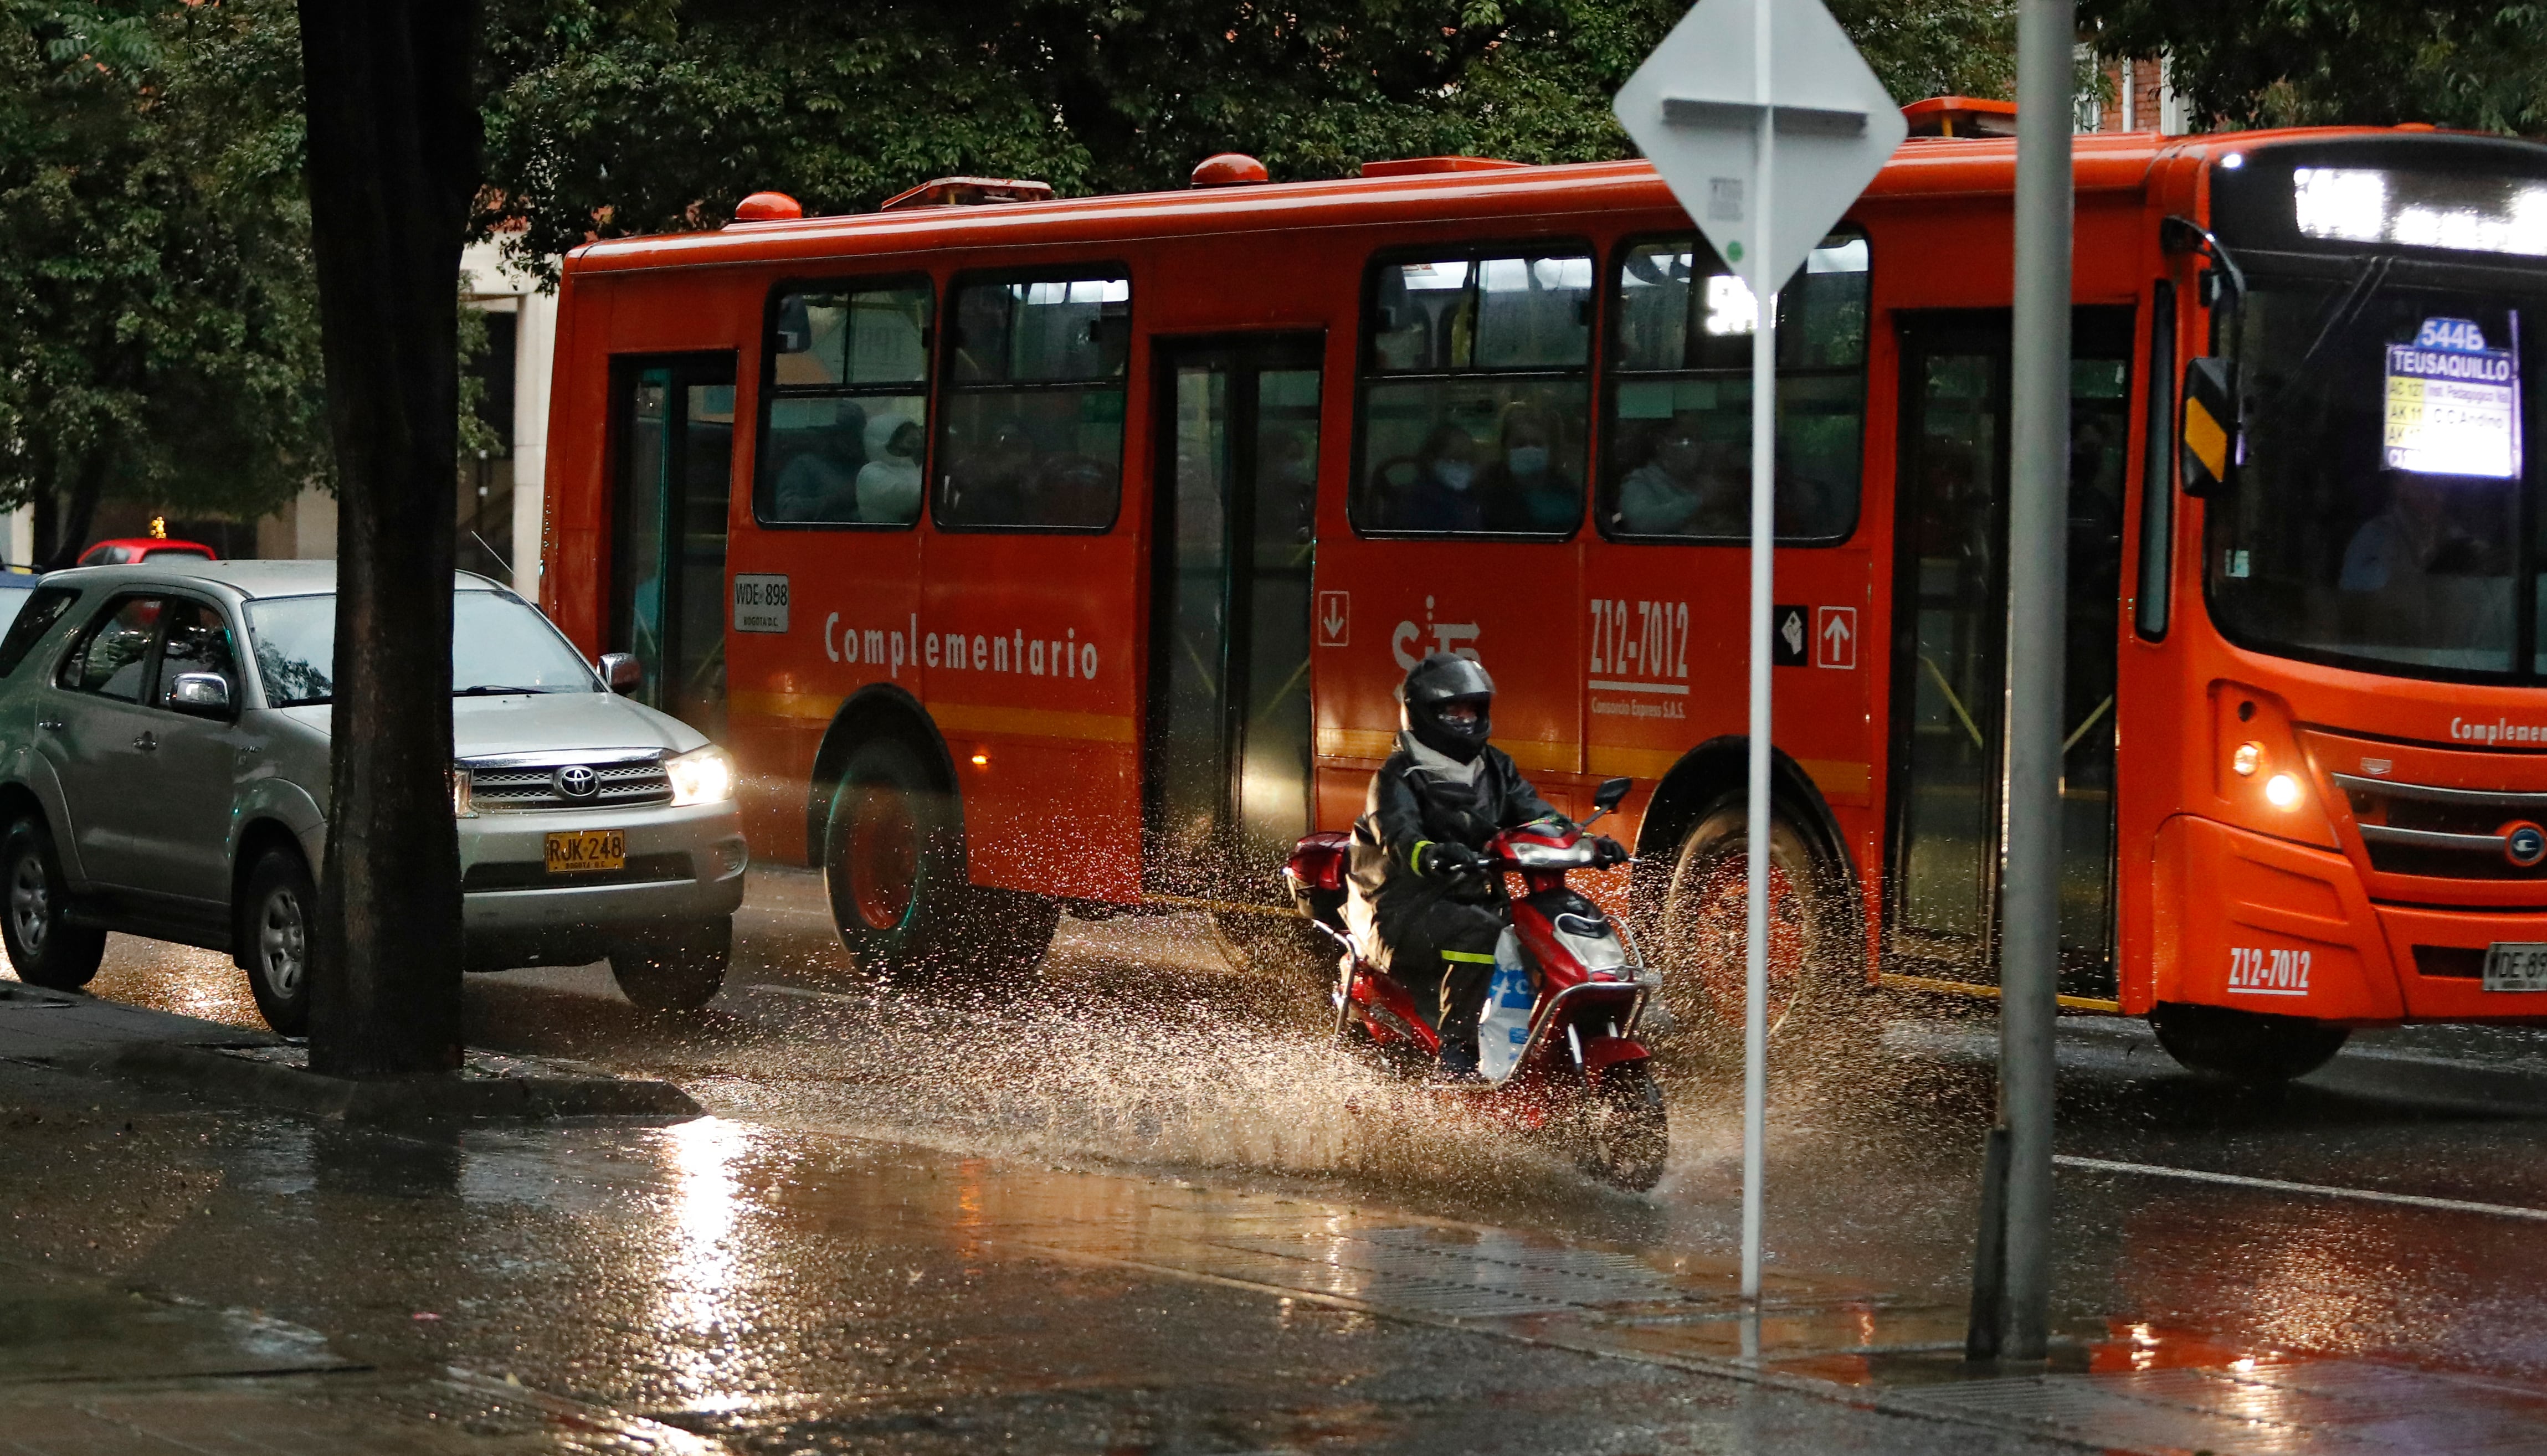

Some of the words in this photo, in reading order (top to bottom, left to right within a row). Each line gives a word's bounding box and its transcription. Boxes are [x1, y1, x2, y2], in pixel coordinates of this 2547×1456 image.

[2394, 350, 2510, 381] TEUSAQUILLO
[825, 611, 1097, 679] Complementario
[1590, 599, 1688, 678] Z12-7012
[1591, 697, 1630, 714] Consorcio
[1631, 699, 1662, 719] Express
[2228, 948, 2310, 987] Z12-7012
